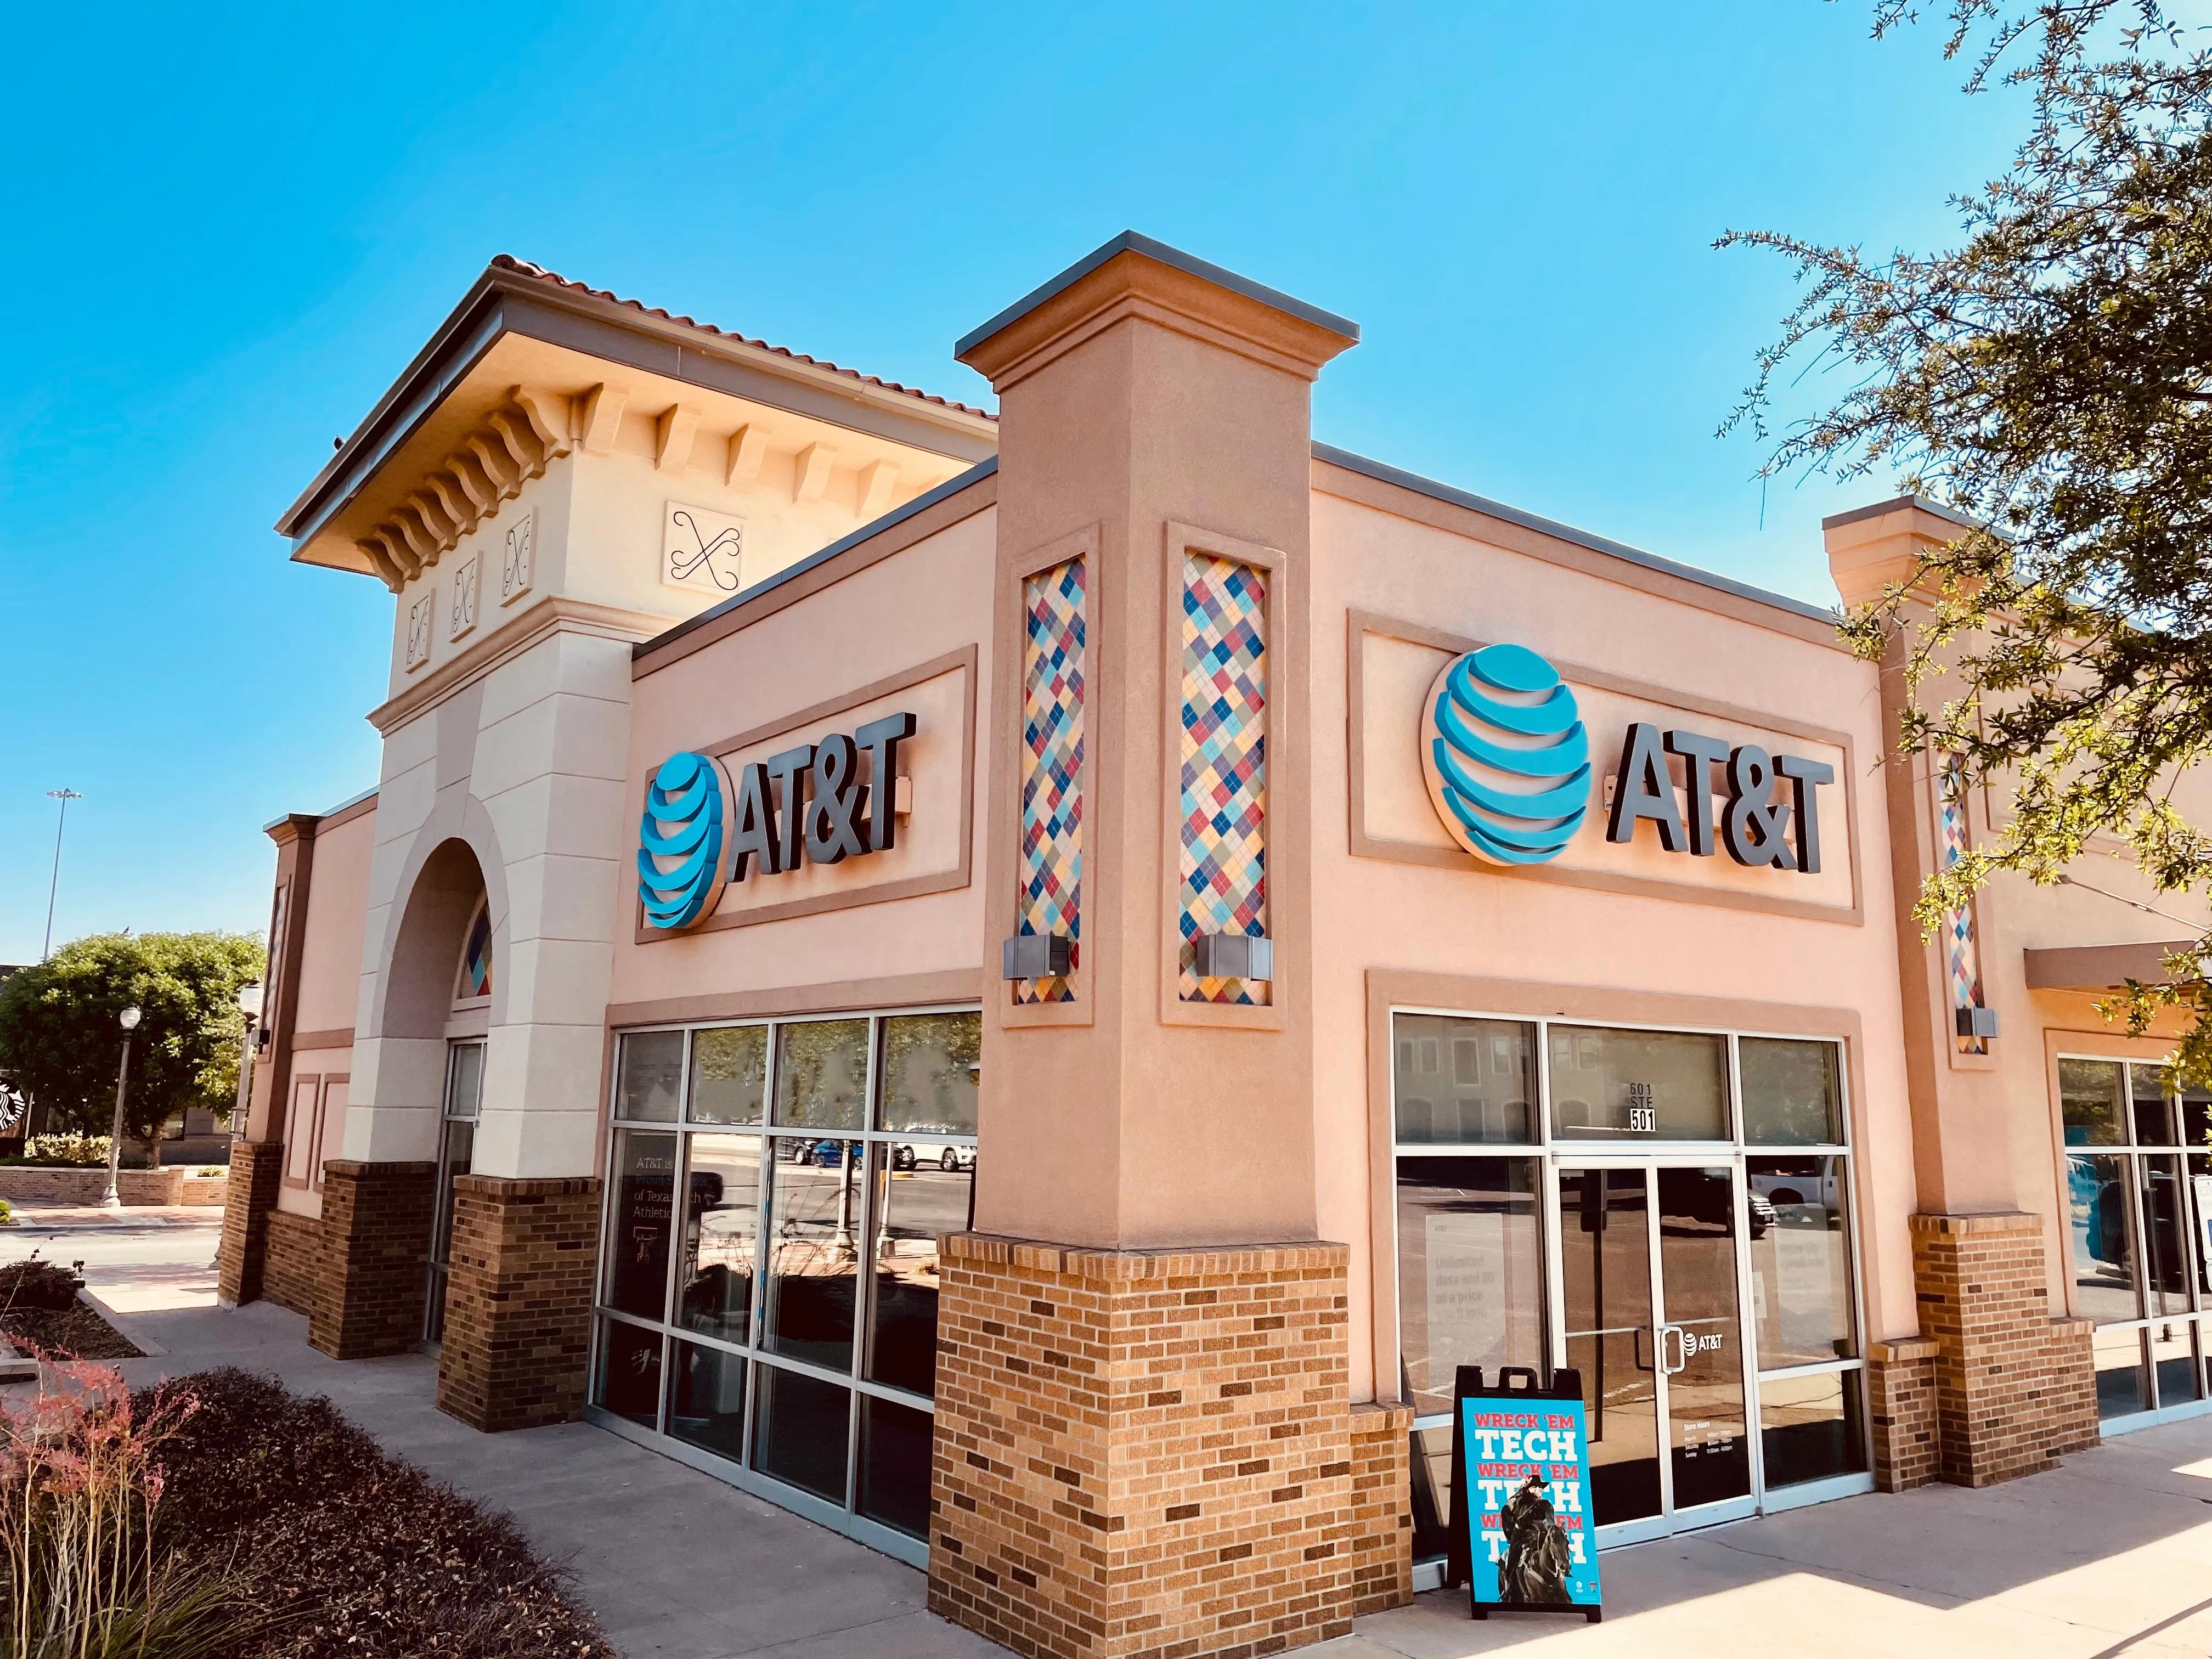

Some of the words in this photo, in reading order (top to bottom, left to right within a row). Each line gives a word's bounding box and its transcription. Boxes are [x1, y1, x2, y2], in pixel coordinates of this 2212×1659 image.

[725, 712, 917, 883] AT&T
[1606, 722, 1834, 873] AT&T
[1630, 1082, 1650, 1096] 601
[1630, 1096, 1654, 1109] STE
[1632, 1110, 1654, 1131] 501
[636, 1157, 663, 1169] AT&T
[665, 1160, 674, 1170] is
[634, 1189, 645, 1201] of
[647, 1190, 673, 1202] Texas
[633, 1206, 672, 1218] Athletic
[1435, 1255, 1484, 1269] Unlimited
[1482, 1271, 1495, 1284] 5G
[1458, 1288, 1483, 1308] price
[1698, 1334, 1723, 1351] AT&T
[1474, 1413, 1539, 1429] WRECK
[1543, 1414, 1575, 1429] 'EM
[1475, 1429, 1578, 1462] TECH
[1477, 1463, 1543, 1479] WRECK
[1547, 1464, 1578, 1479] 'EM
